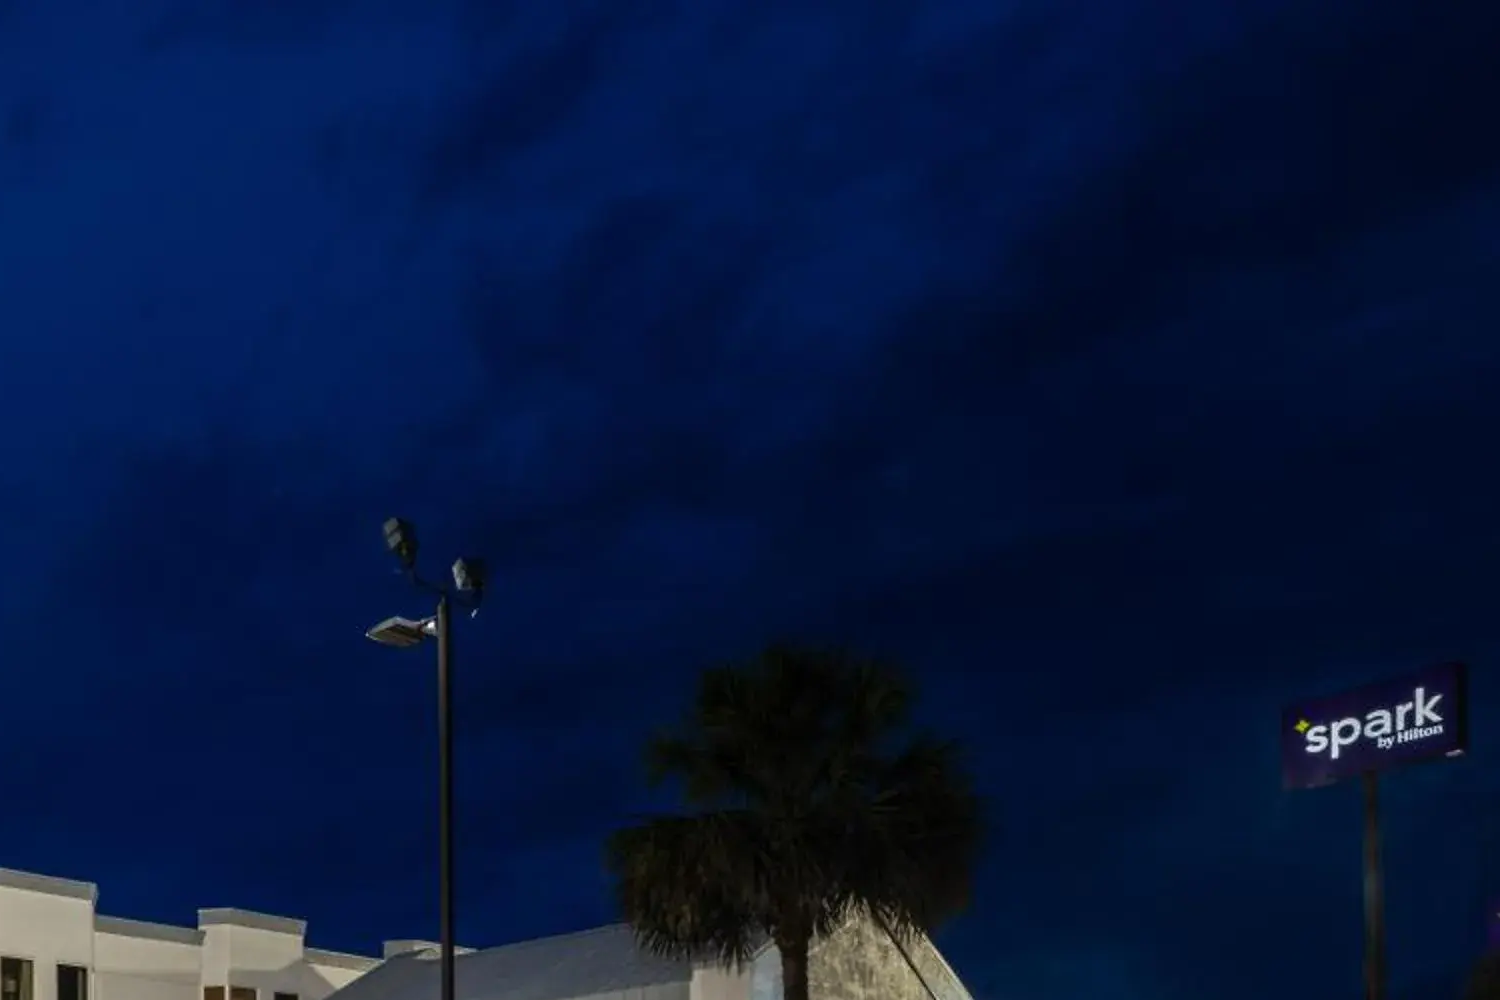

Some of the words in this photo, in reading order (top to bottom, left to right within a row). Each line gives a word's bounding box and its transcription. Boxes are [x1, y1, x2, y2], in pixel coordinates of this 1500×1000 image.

[1305, 687, 1444, 760] spark
[1377, 735, 1395, 749] by
[1397, 724, 1444, 744] Hilton
